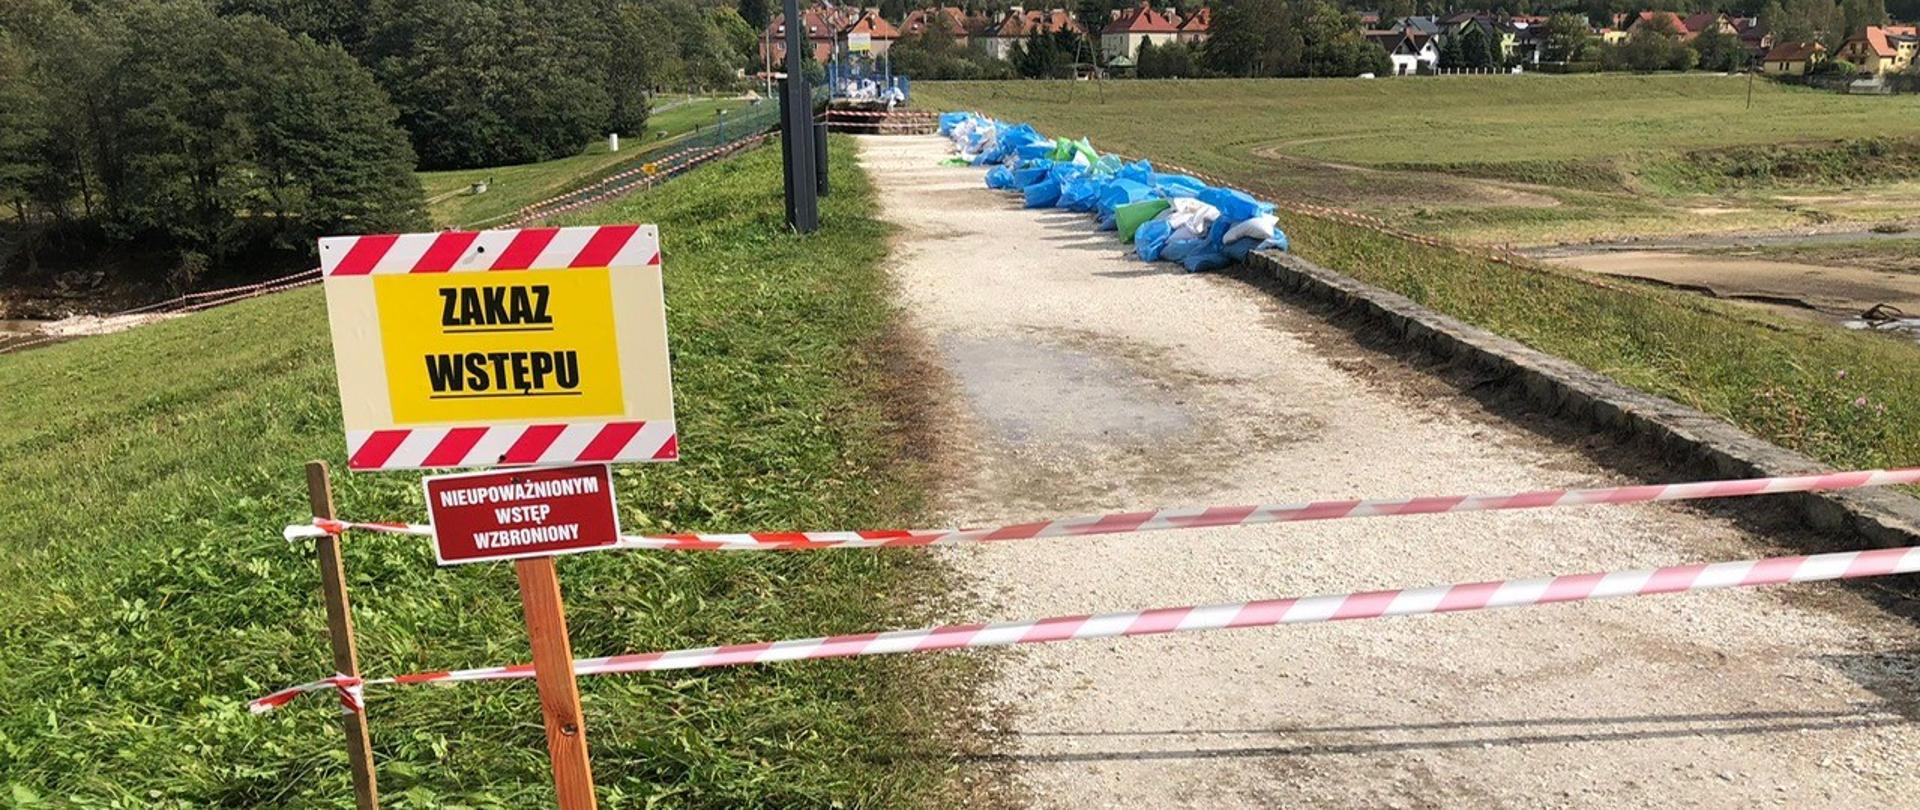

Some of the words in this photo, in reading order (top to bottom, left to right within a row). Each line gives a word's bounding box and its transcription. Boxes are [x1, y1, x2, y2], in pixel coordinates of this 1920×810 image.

[439, 285, 553, 326] ZAKAZ
[425, 351, 579, 395] WSTĘPU
[440, 476, 599, 507] NIEUPOWAŻNIONYM
[495, 504, 550, 524] WSTĘP
[474, 523, 579, 549] WZBRONIONY
